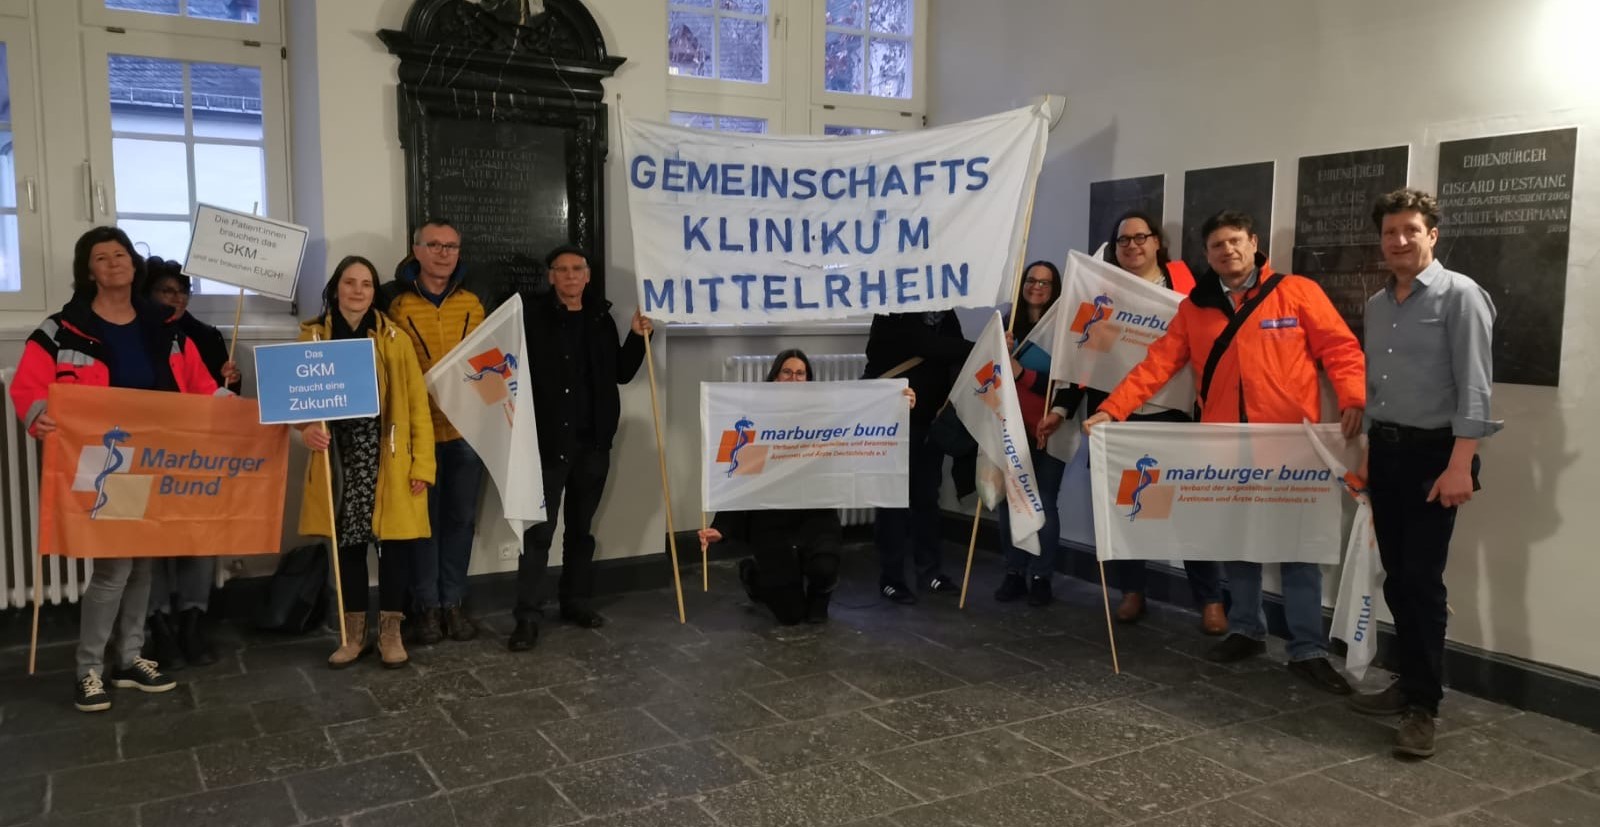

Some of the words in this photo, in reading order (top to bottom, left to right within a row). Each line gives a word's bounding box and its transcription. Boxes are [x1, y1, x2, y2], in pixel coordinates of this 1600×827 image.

[1463, 147, 1547, 168] EHRENBÜRGER
[630, 154, 990, 200] GEMEINSCHAFTS
[215, 214, 229, 225] Die
[219, 227, 259, 244] brauchen
[261, 238, 277, 249] das
[683, 215, 930, 255] KLINIKUM
[223, 241, 258, 260] GKM
[219, 260, 252, 273] brauchen
[253, 265, 284, 280] EUCH!
[643, 262, 969, 314] MITTELRHEIN
[304, 350, 324, 359] Das
[296, 362, 335, 378] GKM
[289, 382, 323, 393] braucht
[325, 382, 345, 391] eine
[289, 394, 348, 411] Zukunft!
[760, 425, 850, 441] marburger
[853, 422, 899, 437] bund
[139, 448, 266, 477] Marburger
[1165, 465, 1272, 483] marburger
[1279, 465, 1331, 482] bund
[158, 475, 222, 496] Bund
